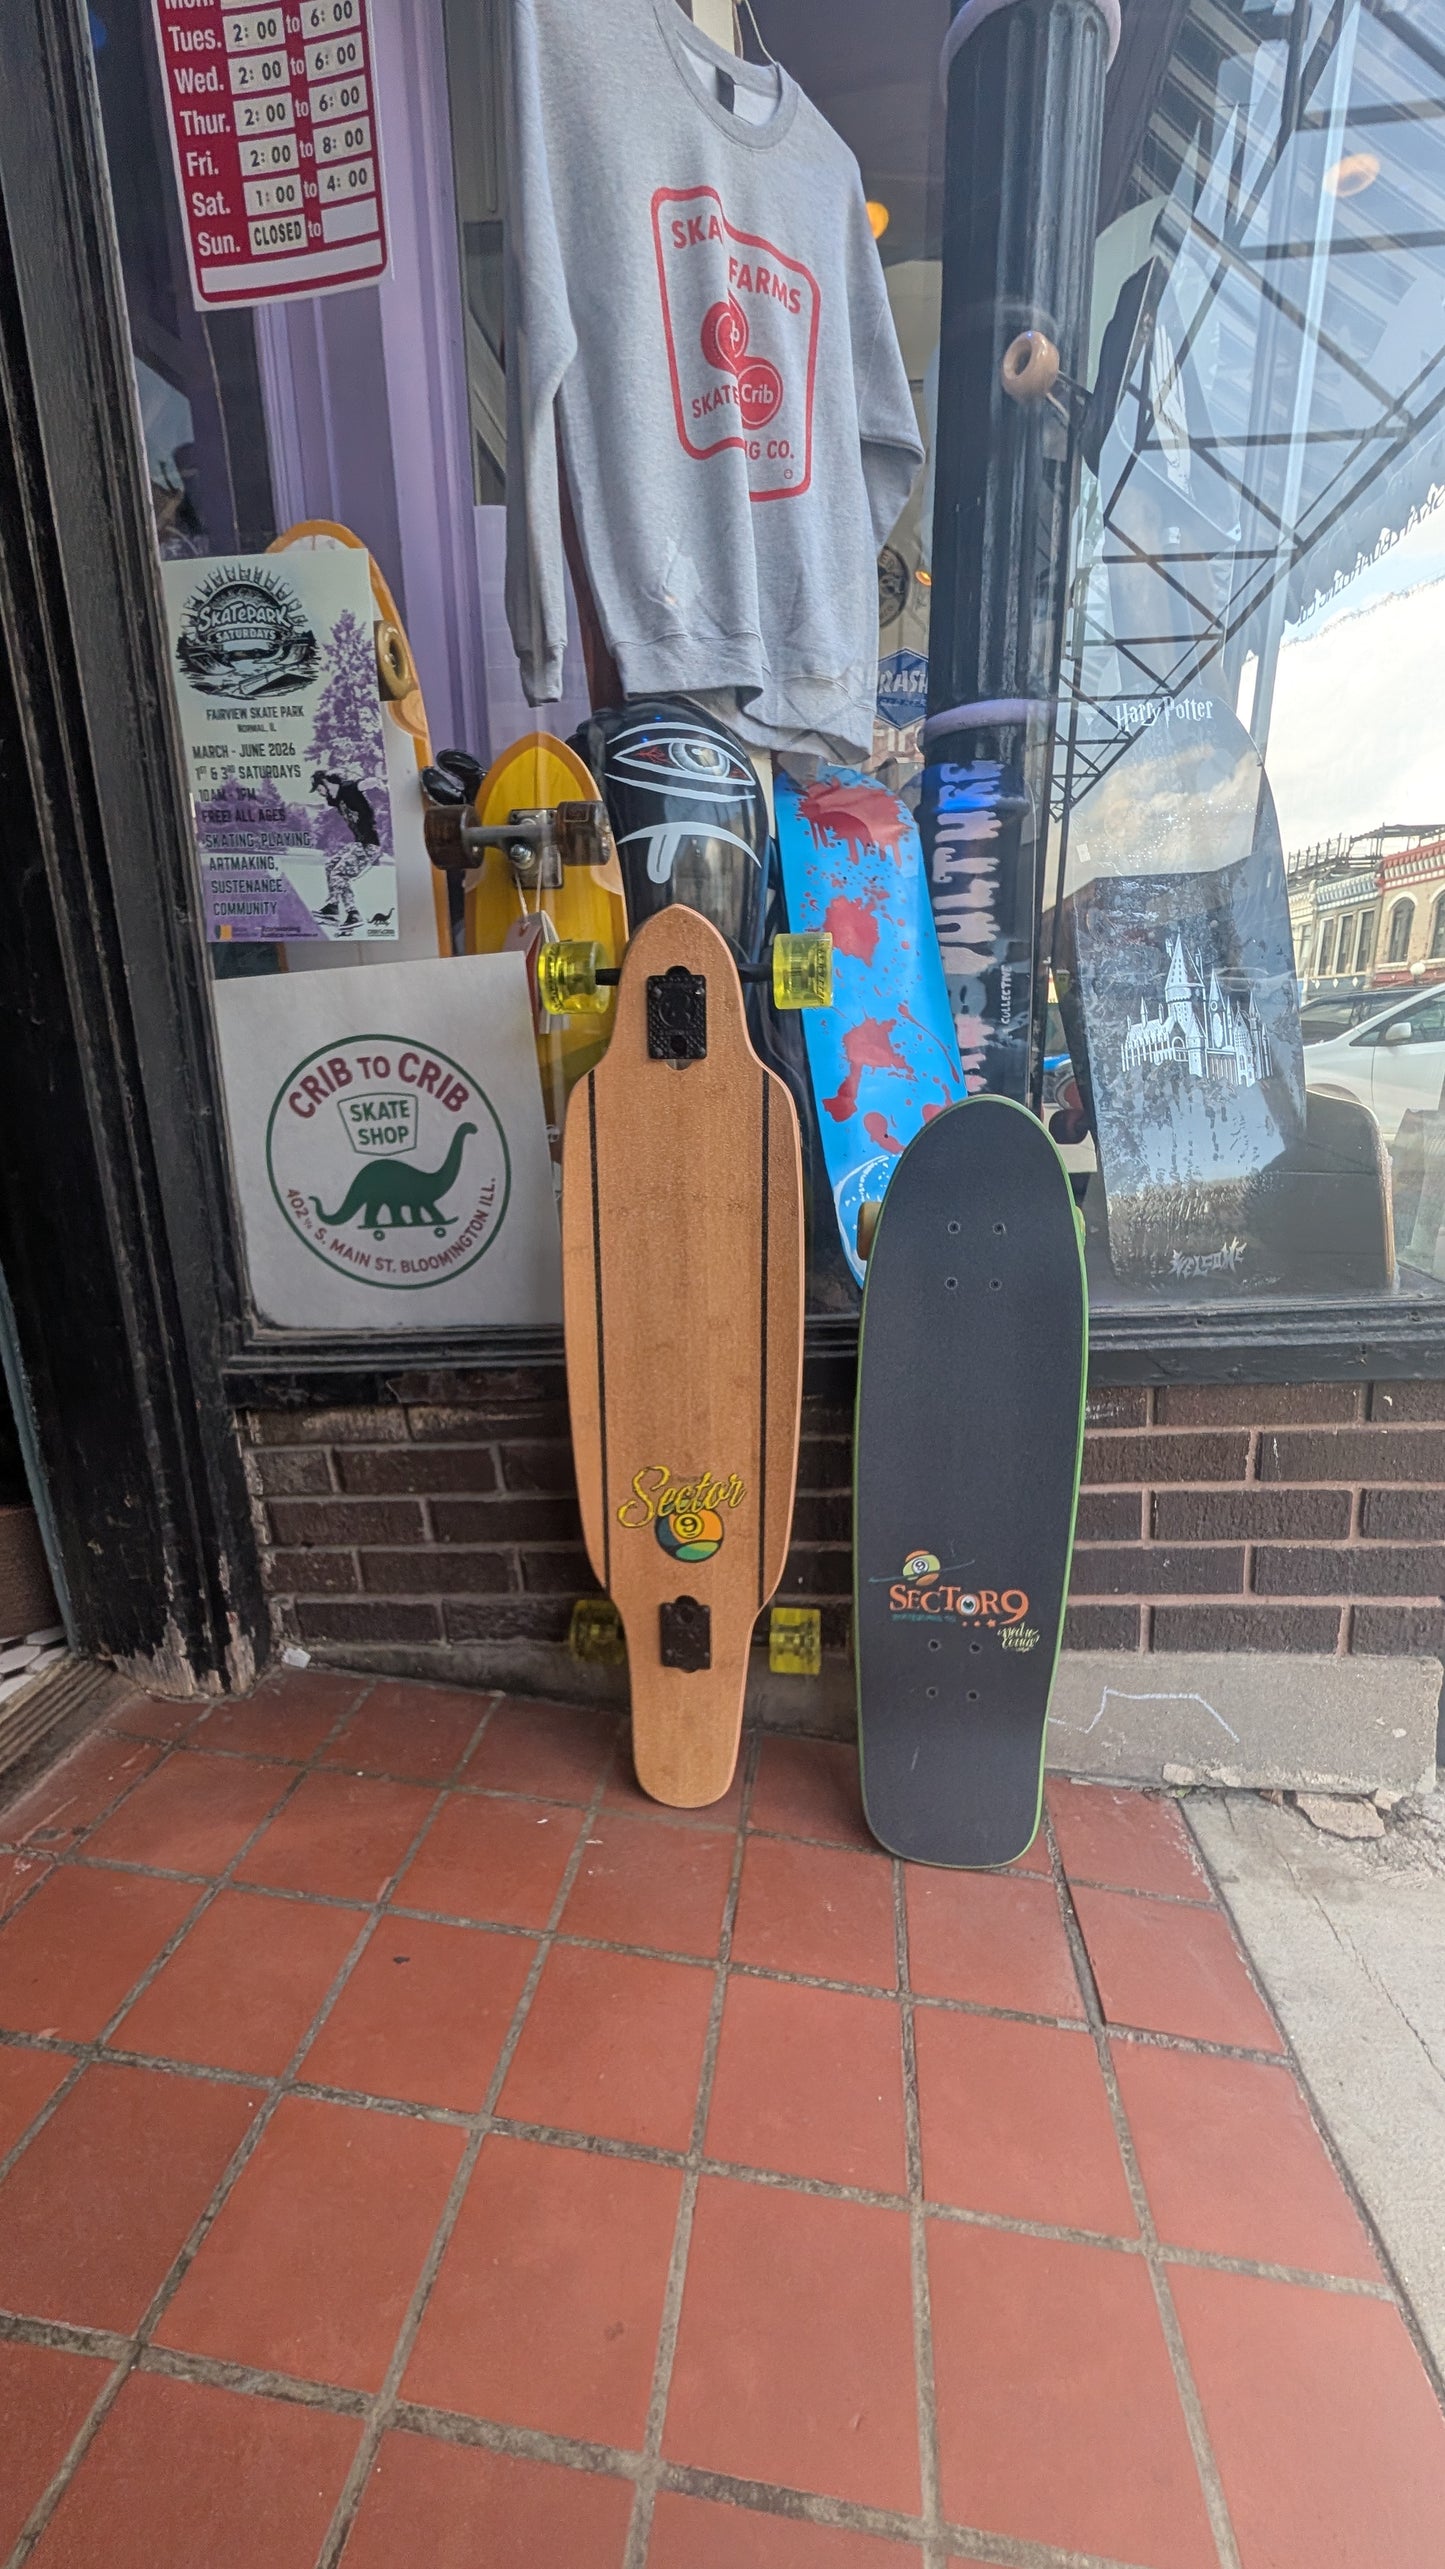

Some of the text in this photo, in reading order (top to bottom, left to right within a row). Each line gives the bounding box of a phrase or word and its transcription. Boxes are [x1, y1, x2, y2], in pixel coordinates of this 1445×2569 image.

[168, 25, 222, 52] Tues.
[286, 15, 300, 34] to
[174, 66, 225, 94] Wed.
[290, 56, 305, 76] to
[180, 110, 231, 136] Thur.
[295, 98, 309, 117] to
[186, 152, 219, 177] Fri.
[299, 141, 313, 159] to
[192, 191, 231, 217] Sat.
[304, 180, 317, 198] to
[198, 219, 321, 257] Sun. CLOSED to
[728, 256, 801, 315] FARMS
[741, 382, 774, 404] Crib
[767, 440, 795, 460] CO.
[215, 628, 277, 642] SATURDAYS
[206, 705, 304, 720] FAIRVIEW SKATE PARK
[1115, 696, 1213, 736] Harry Potter
[192, 745, 229, 759] MARCH
[240, 743, 266, 757] JUNE
[269, 742, 296, 757] 2026
[210, 767, 218, 780] &
[238, 764, 301, 779] SATURDAYS
[235, 809, 255, 822] ALL
[258, 808, 286, 821] AGES
[260, 832, 314, 847] PLAYING,
[209, 856, 279, 871] ARTMAKING,
[211, 879, 287, 894] SUSTENANCE,
[213, 901, 278, 916] COMMUNITY
[288, 1052, 470, 1119] CRIB TO CRIB
[350, 1100, 410, 1123] SKATE
[358, 1125, 409, 1146] SHOP
[314, 1227, 327, 1245] S.
[330, 1238, 370, 1268] MAIN
[375, 1258, 396, 1273] ST.
[401, 1212, 489, 1274] BLOOMINGTON
[481, 1177, 496, 1208] ILL.
[617, 1465, 747, 1528] Sector
[680, 1517, 698, 1533] 9
[916, 1561, 926, 1571] 9
